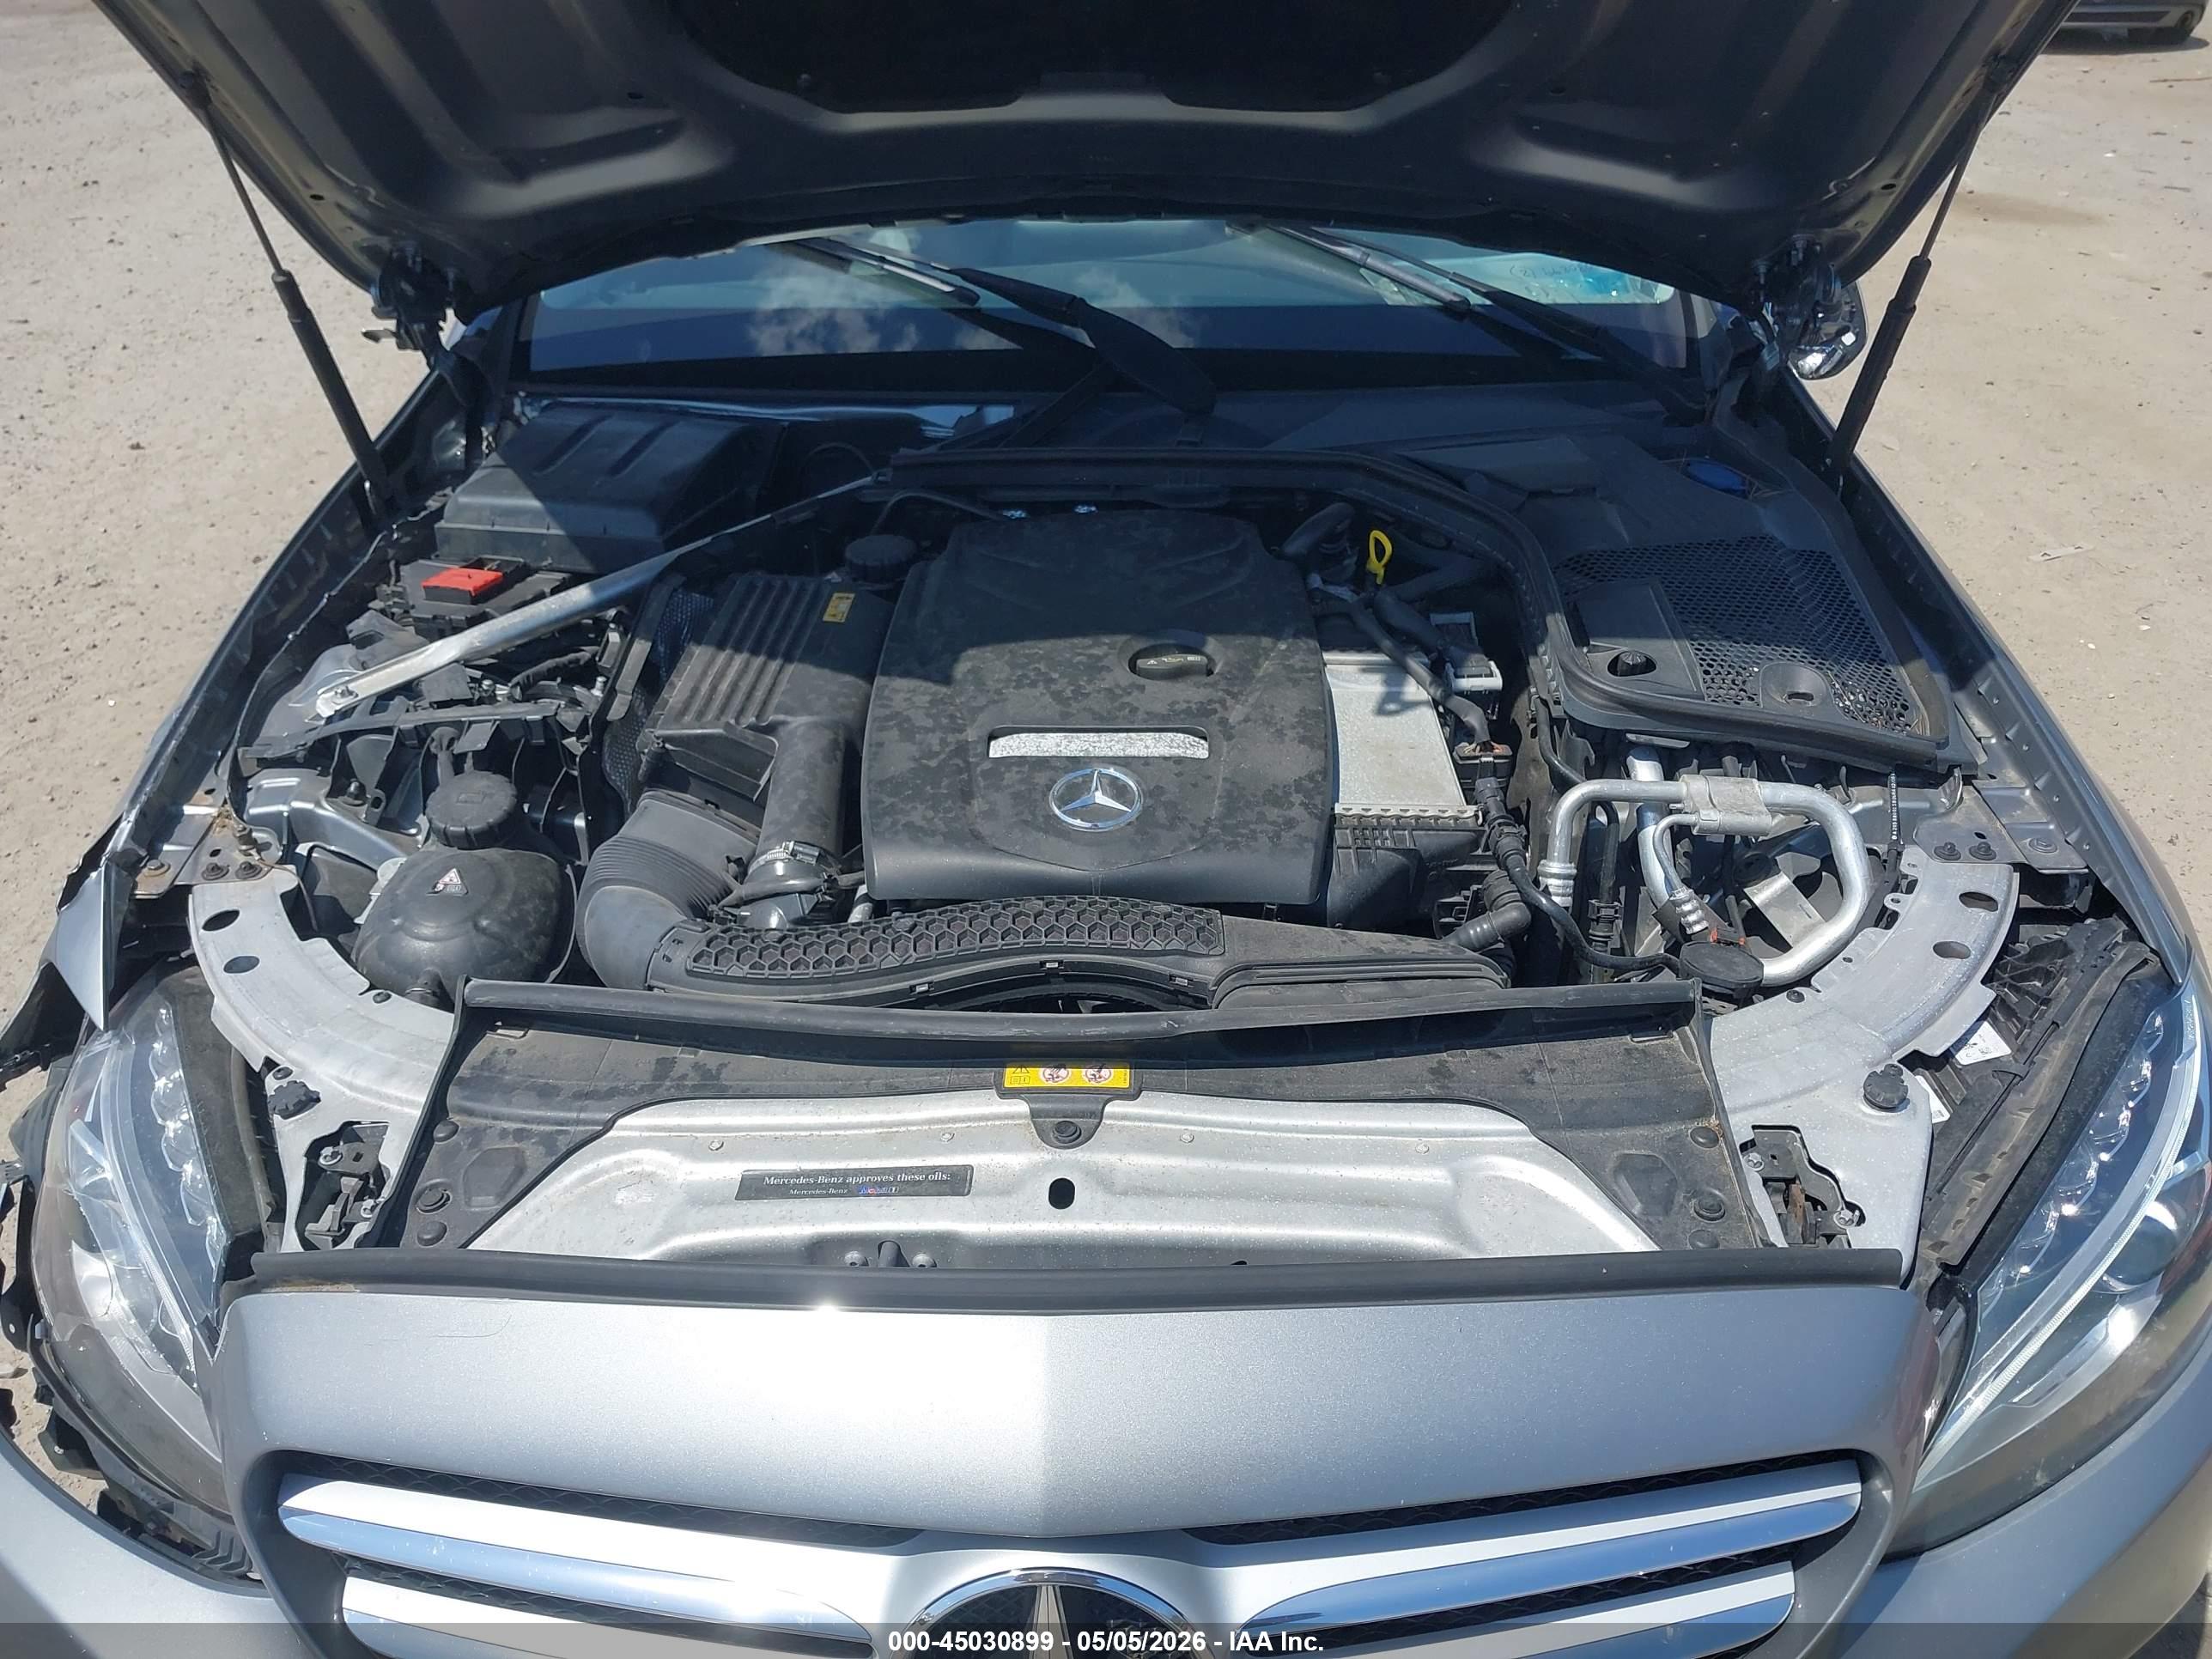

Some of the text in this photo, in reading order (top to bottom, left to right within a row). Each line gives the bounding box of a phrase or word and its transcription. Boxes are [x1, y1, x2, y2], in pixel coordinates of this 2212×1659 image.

[763, 1171, 951, 1185] Mercedes-Benz approves these oils:
